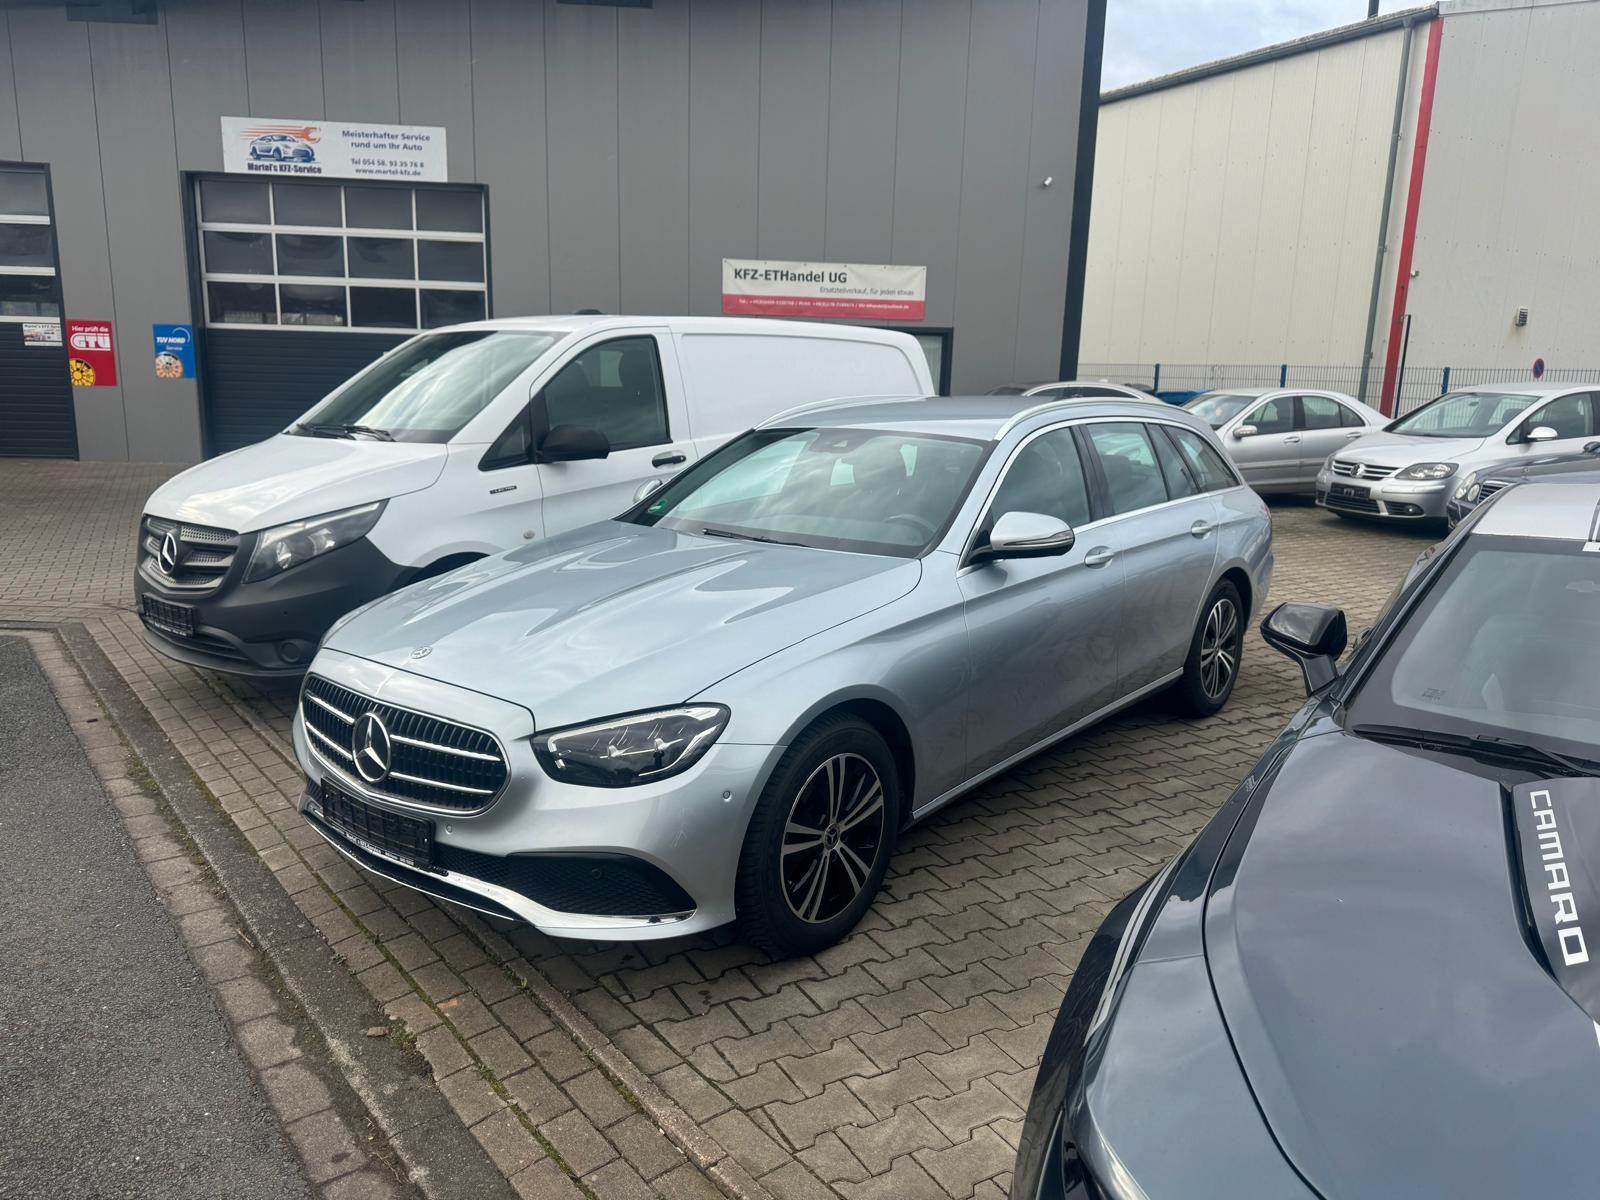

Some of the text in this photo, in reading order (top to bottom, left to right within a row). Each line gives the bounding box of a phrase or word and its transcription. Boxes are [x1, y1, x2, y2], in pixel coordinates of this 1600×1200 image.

[342, 130, 431, 141] Meisterhafter Service
[389, 142, 400, 150] Ihr
[402, 143, 423, 151] Auto
[247, 162, 322, 174] Martel's KFZ-Service
[355, 168, 421, 176] www.martel-kfz.de
[733, 268, 848, 284] KFZ-ETHandel UG
[819, 286, 869, 296] Ersatzteilverkauf,
[870, 287, 879, 295] für
[880, 288, 896, 296] jeden
[84, 325, 99, 333] prüft
[1529, 789, 1590, 967] CAMARO
